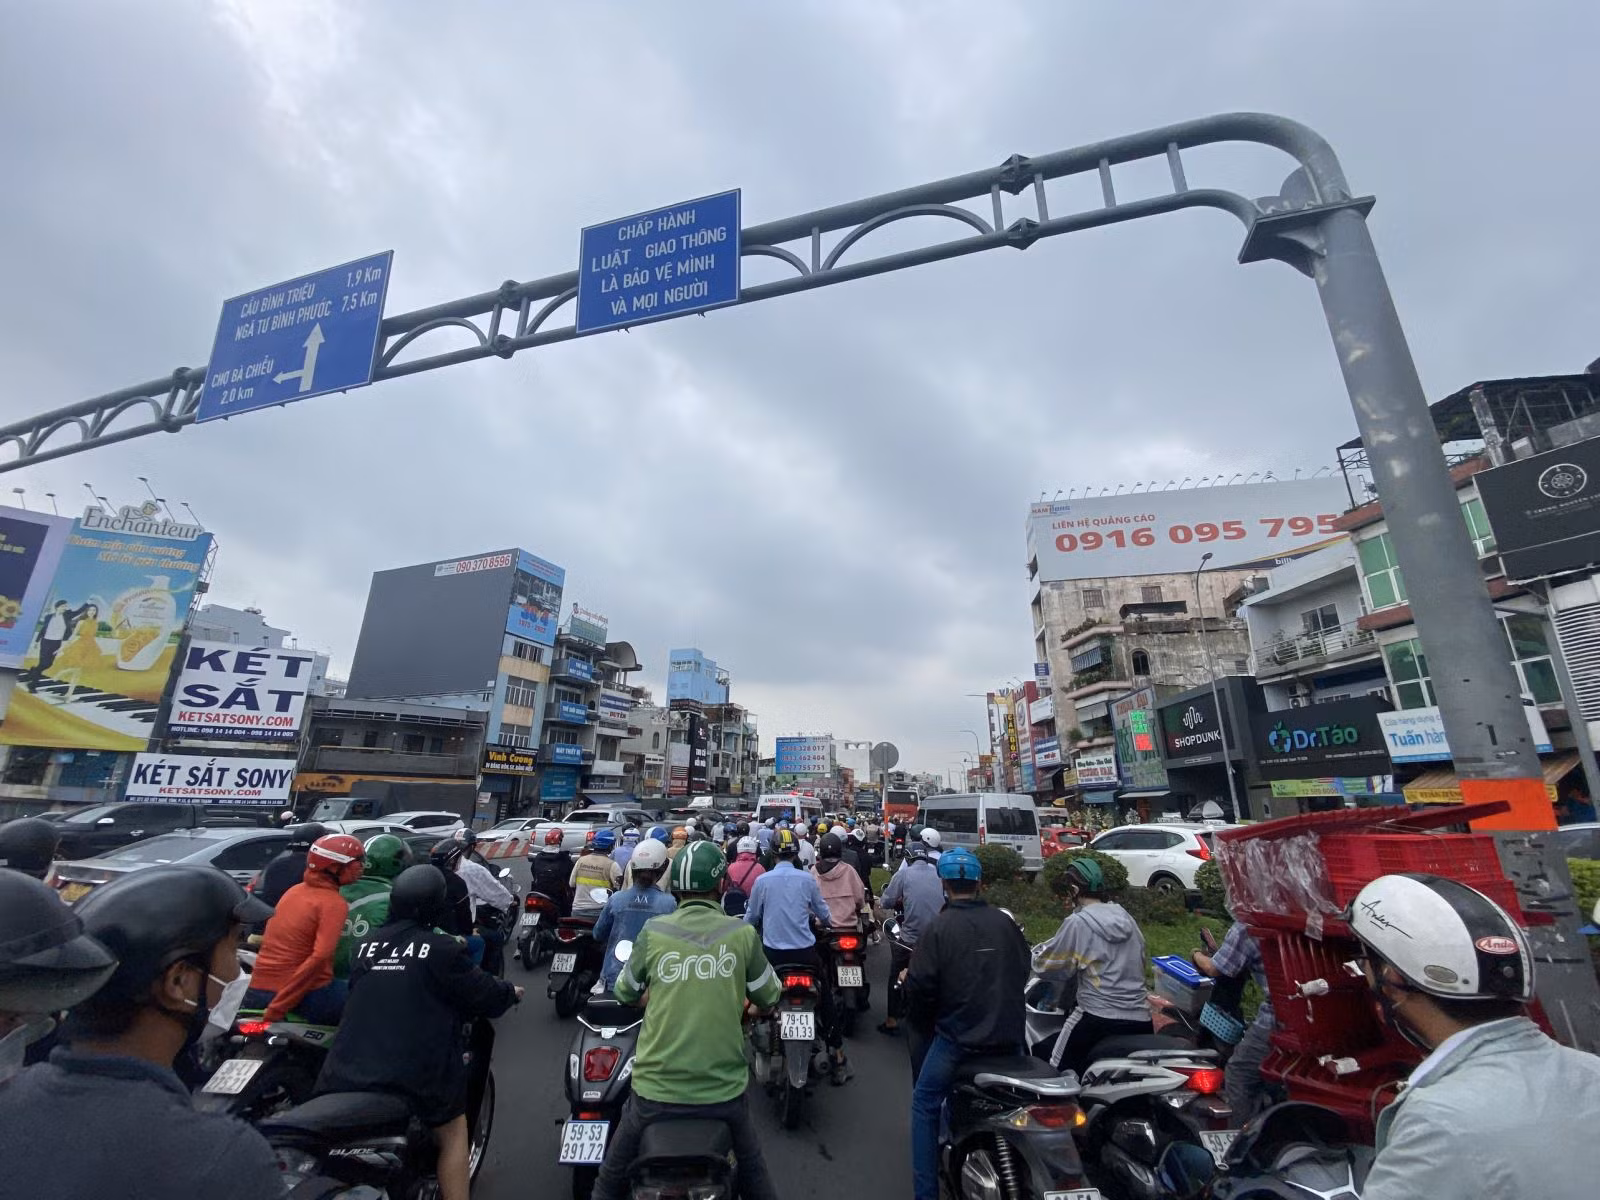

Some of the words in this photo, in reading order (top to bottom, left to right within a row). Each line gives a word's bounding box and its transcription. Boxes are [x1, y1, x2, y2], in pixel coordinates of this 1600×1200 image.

[618, 217, 653, 241] CHẤP
[657, 209, 696, 232] HÀNH
[592, 249, 631, 273] LUẬT
[645, 239, 676, 259] GIAO
[681, 226, 727, 250] THÔNG
[347, 269, 362, 288] 1.9
[364, 267, 382, 282] Km
[601, 274, 618, 293] LÀ
[623, 266, 649, 289] BẢO
[655, 261, 673, 282] VỆ
[677, 254, 715, 277] MÌNH
[260, 289, 284, 314] BÌNH
[287, 282, 315, 305] TRIỆU
[341, 296, 357, 313] 7.5
[359, 292, 378, 307] Km
[611, 296, 627, 316] VÀ
[632, 292, 658, 312] MỌI
[664, 277, 708, 305] NGƯỜI
[271, 311, 295, 332] BÌNH
[297, 298, 332, 324] PHƯỚC
[212, 373, 230, 388] CHỢ
[231, 367, 243, 383] BÀ
[245, 355, 274, 379] CHIỂU
[220, 390, 236, 405] 2.0
[237, 387, 254, 402] km
[83, 507, 203, 540] Enchanteur
[1052, 518, 1074, 530] LIÊN
[1077, 518, 1090, 528] HỆ
[1093, 515, 1131, 527] QUẢNG
[1133, 513, 1156, 522] CÁO
[1055, 527, 1156, 552] 0916
[1168, 520, 1247, 544] 095
[1259, 514, 1344, 538] 795
[456, 562, 471, 573] 090
[472, 559, 488, 571] 370
[489, 555, 511, 568] 8596
[185, 647, 313, 678] KÉT
[178, 678, 304, 712] SẮT
[178, 711, 294, 727] KETSATSONY.COM
[171, 726, 200, 734] HOTLINE:
[1174, 730, 1221, 748] SHOPDUNK
[1292, 723, 1358, 749] Dr.Táo
[1389, 728, 1424, 748] Tuấn
[133, 759, 181, 785] KÉT
[185, 758, 230, 787] SẮT
[234, 767, 292, 789] SONY
[159, 786, 262, 796] KETSATSONY.COM
[634, 895, 649, 904] A/X
[357, 941, 431, 959] TELAB
[657, 944, 737, 984] Grab
[786, 1013, 809, 1025] 79-C1
[304, 1030, 325, 1040] 150
[782, 1026, 812, 1039] 461.33
[570, 1124, 603, 1141] 59-S3
[328, 1148, 377, 1157] BLADE
[561, 1143, 603, 1161] 391.72
